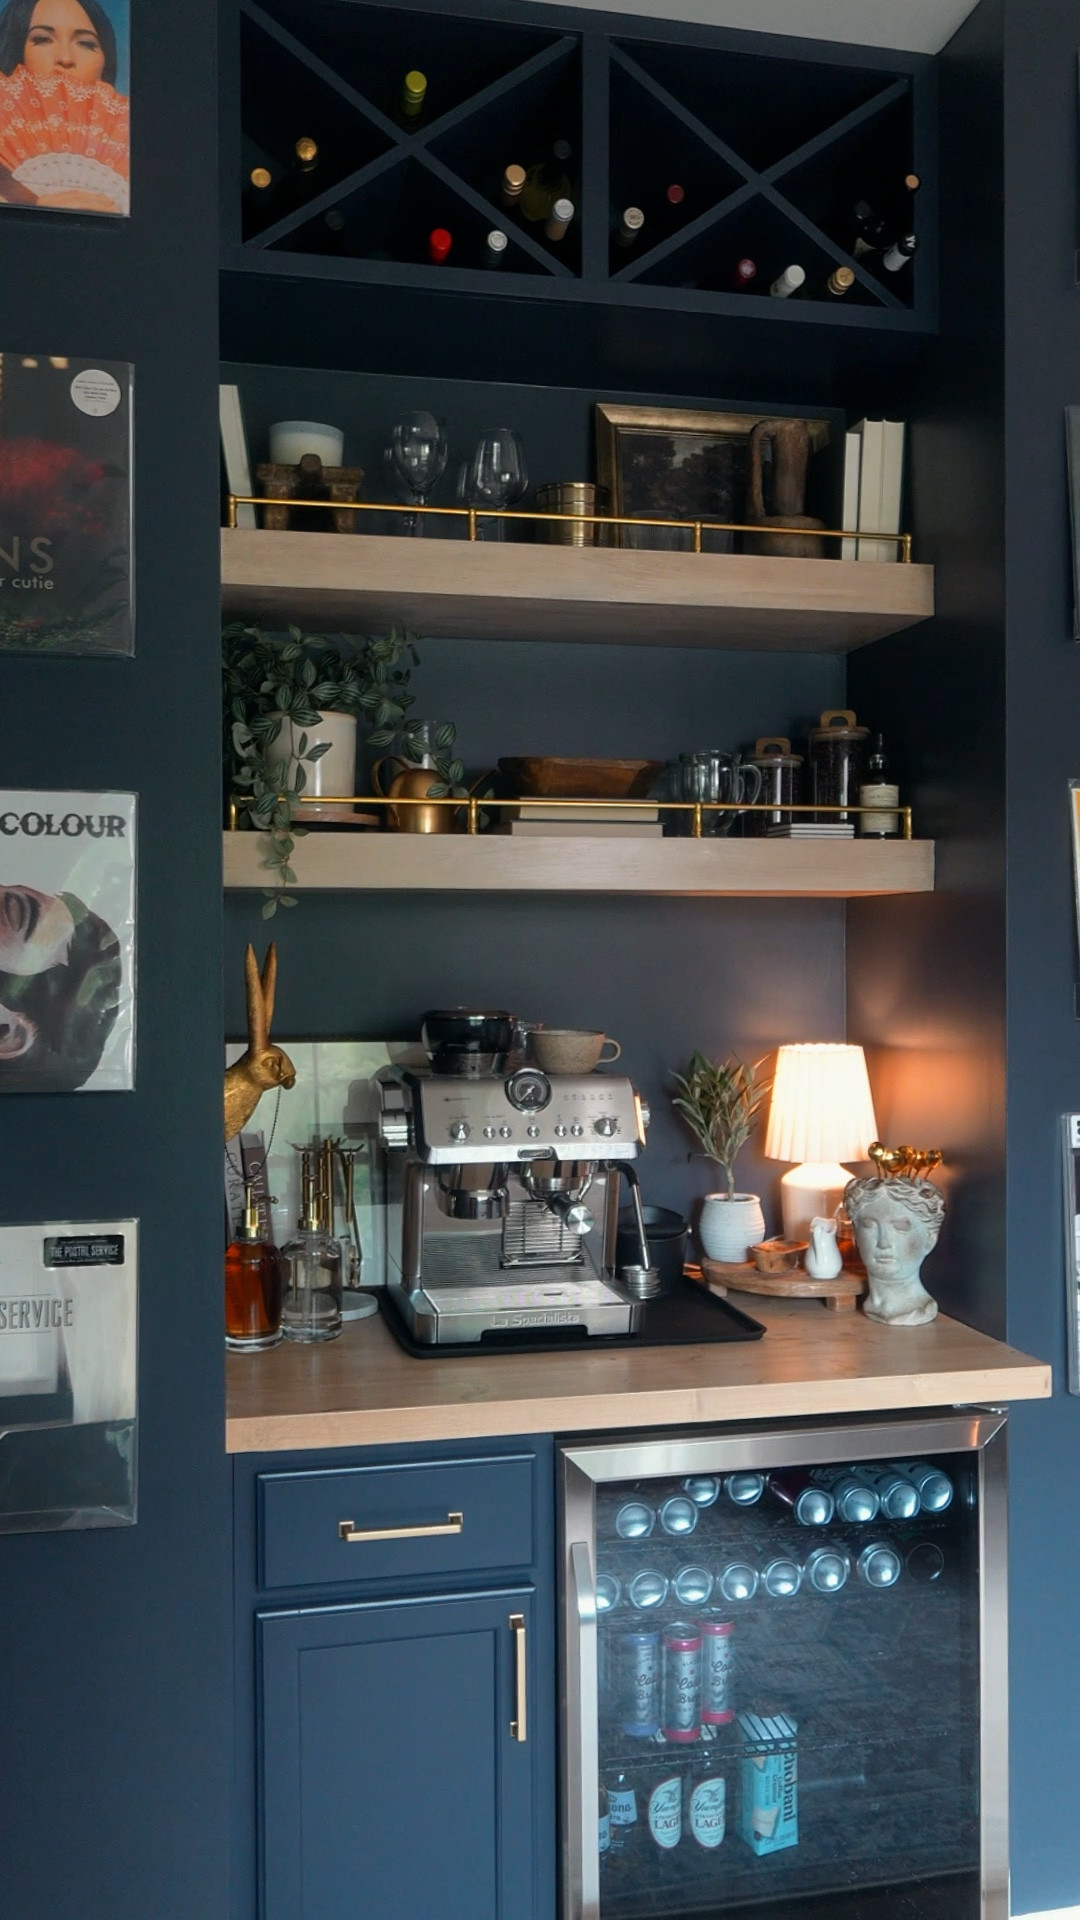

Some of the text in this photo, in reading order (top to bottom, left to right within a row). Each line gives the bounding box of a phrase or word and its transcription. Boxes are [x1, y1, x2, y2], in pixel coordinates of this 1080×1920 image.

[12, 576, 54, 590] cutie
[0, 811, 126, 838] COLOUR
[50, 1244, 119, 1258] THE POSTAL SERVICE
[0, 1299, 73, 1329] SERVICE
[490, 1312, 580, 1327] La Specialista
